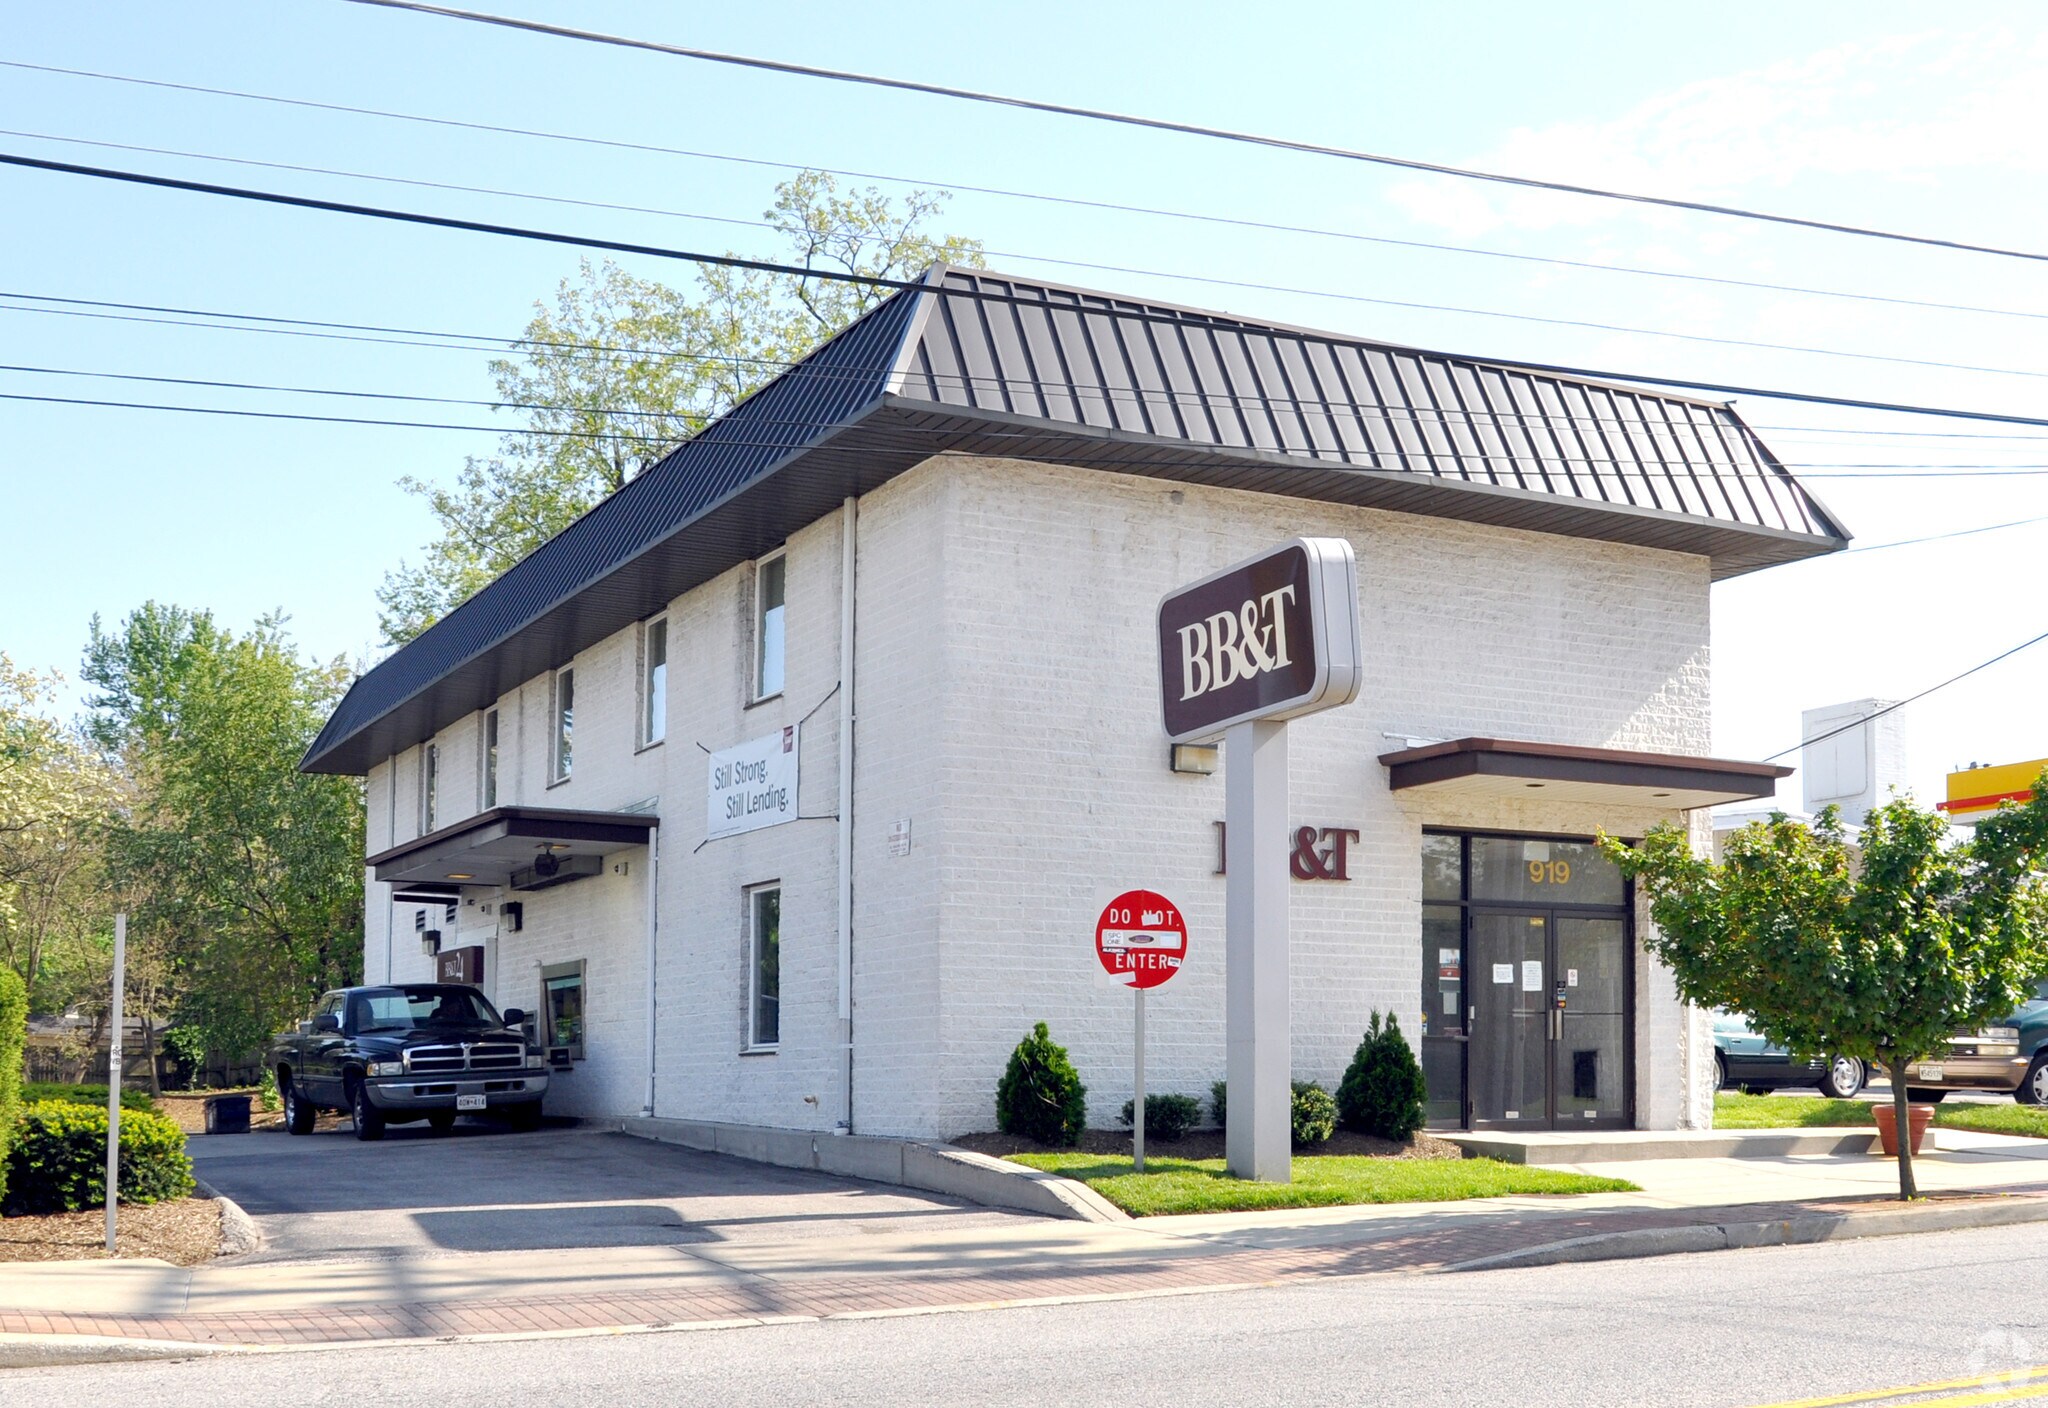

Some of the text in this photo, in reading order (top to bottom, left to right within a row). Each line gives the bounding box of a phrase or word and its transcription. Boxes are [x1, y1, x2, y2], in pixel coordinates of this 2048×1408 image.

[1176, 584, 1295, 701] BB&T
[714, 760, 768, 790] Still Strong.
[726, 784, 788, 819] Still Lending.
[1530, 861, 1570, 884] 919
[1110, 908, 1131, 924] DO
[1116, 953, 1167, 970] ENTER
